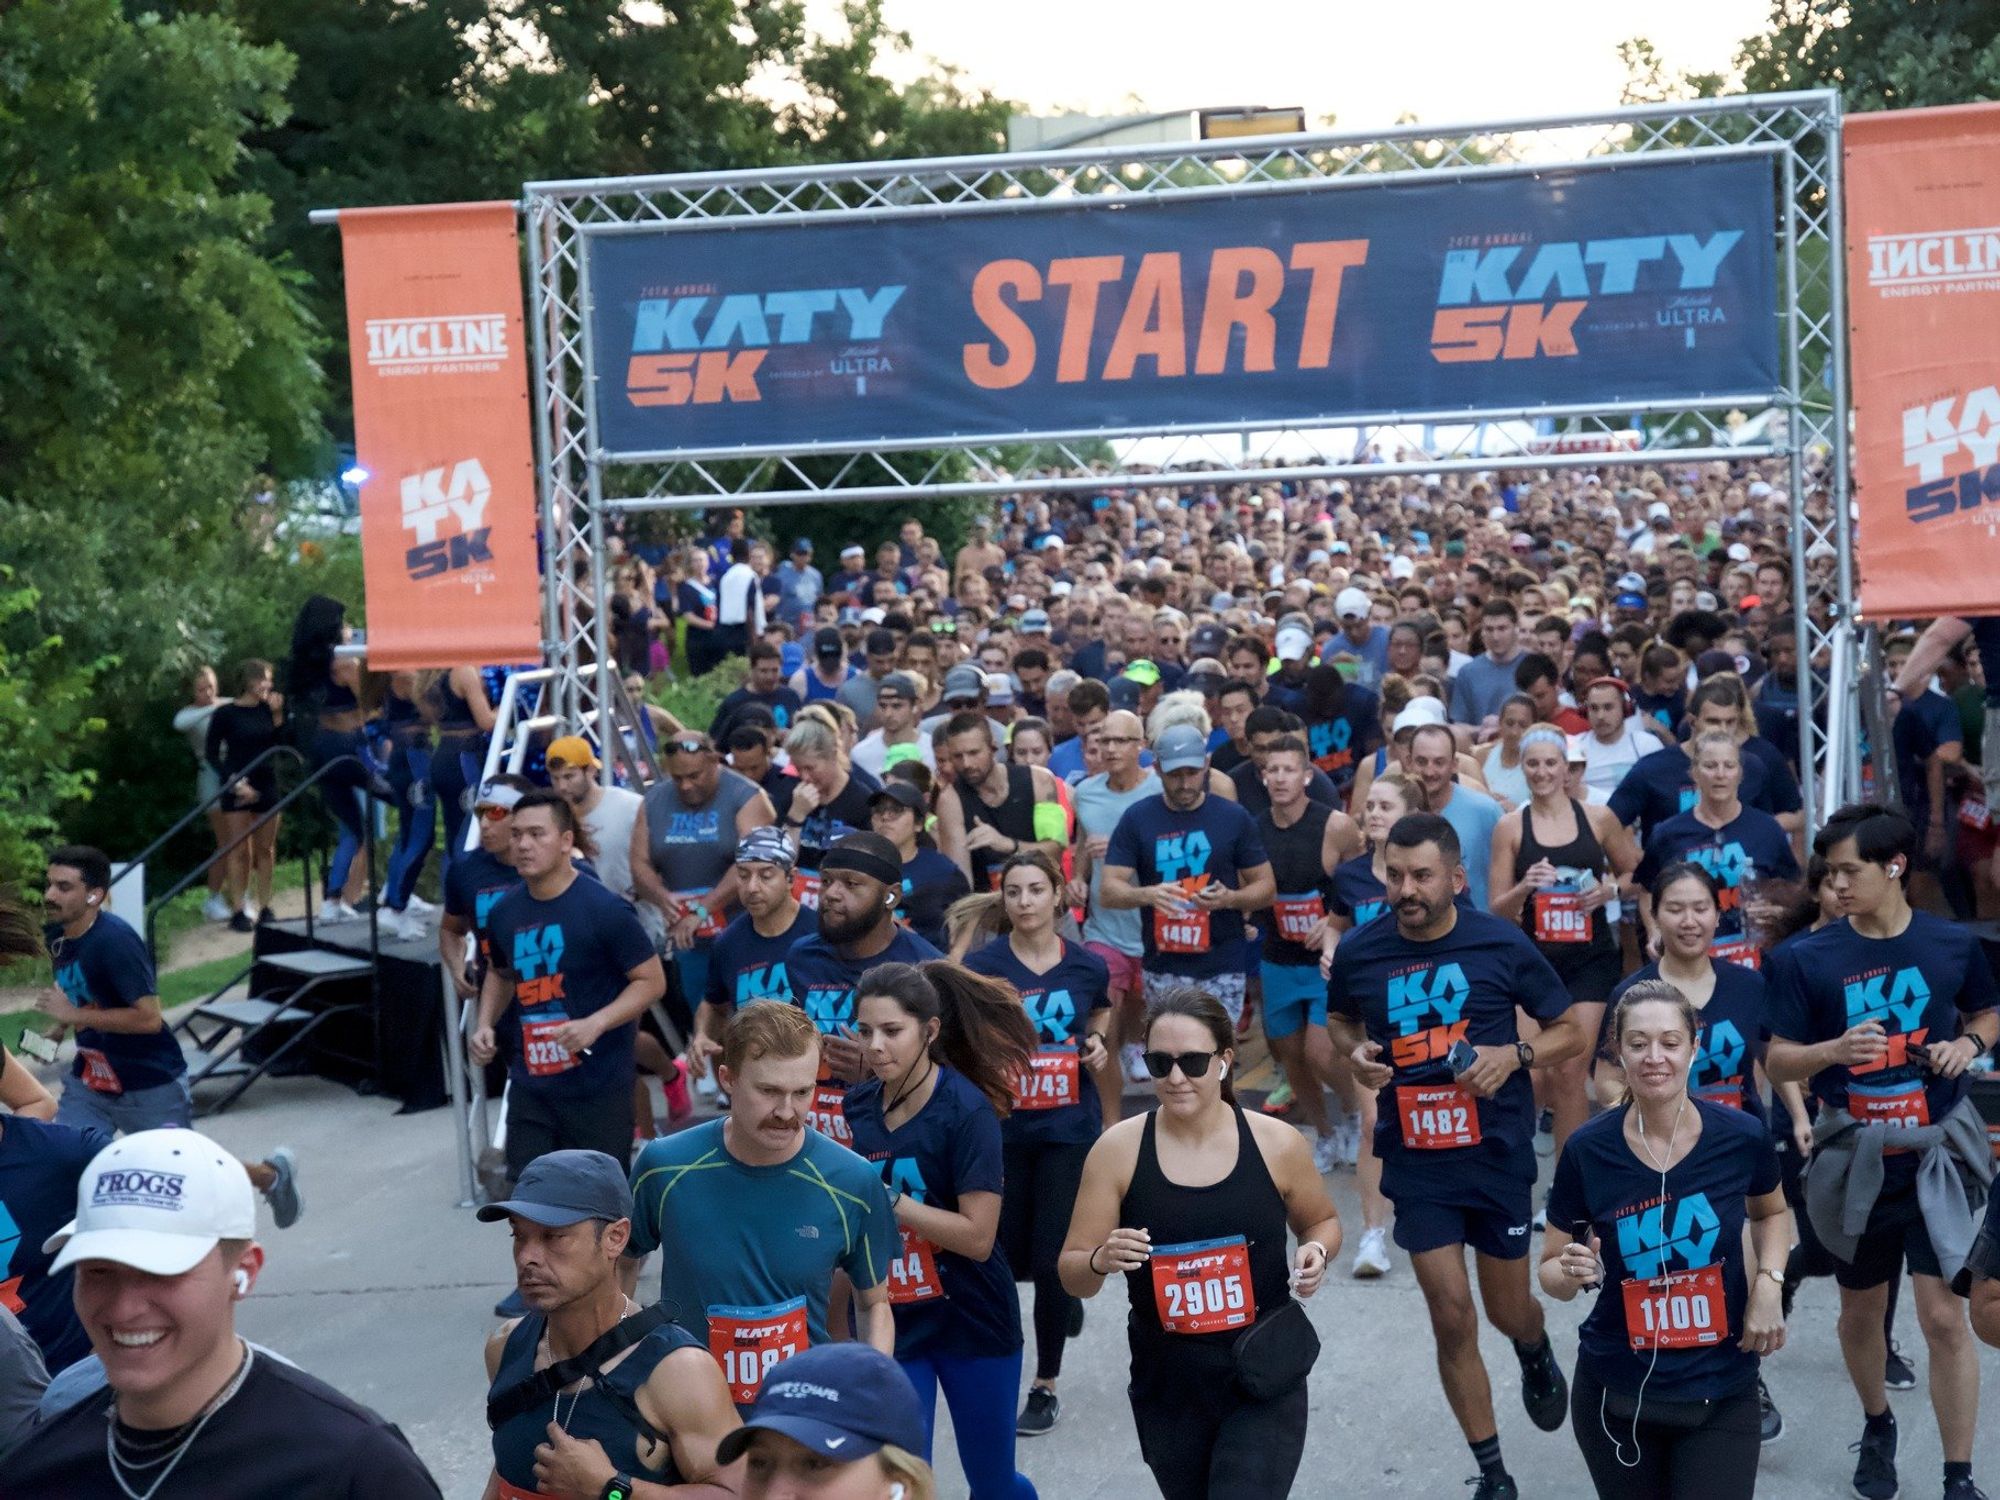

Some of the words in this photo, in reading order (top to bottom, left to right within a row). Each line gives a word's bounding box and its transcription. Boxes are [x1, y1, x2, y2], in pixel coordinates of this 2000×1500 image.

[1438, 230, 1745, 304] KATY
[1881, 284, 1942, 298] ENERGY
[631, 285, 907, 351] KATY
[963, 239, 1369, 389] START
[1656, 306, 1726, 327] ULTRA
[366, 319, 508, 359] INCLINE
[1431, 301, 1588, 363] 5K
[379, 364, 428, 377] ENERGY
[432, 362, 500, 375] PARTNERS
[626, 349, 768, 407] 5K
[830, 357, 893, 375] ULTRA
[1906, 463, 2000, 523] 5K
[406, 527, 494, 580] 5K
[1542, 910, 1585, 931] 1305
[516, 973, 566, 1006] 5K
[1391, 1019, 1471, 1067] 5K
[1417, 1091, 1457, 1102] KATY
[1867, 1100, 1909, 1110] KATY
[1409, 1107, 1469, 1136] 1482
[95, 1172, 183, 1197] FROGS
[1616, 1205, 1635, 1218] 24TH
[1639, 1192, 1672, 1211] ANNUAL
[1177, 1255, 1227, 1271] KATY
[1649, 1274, 1700, 1286] KATY
[1165, 1275, 1244, 1317] 2905
[1640, 1295, 1711, 1331] 1100
[734, 1323, 788, 1339] KATY
[723, 1343, 796, 1385] 1087
